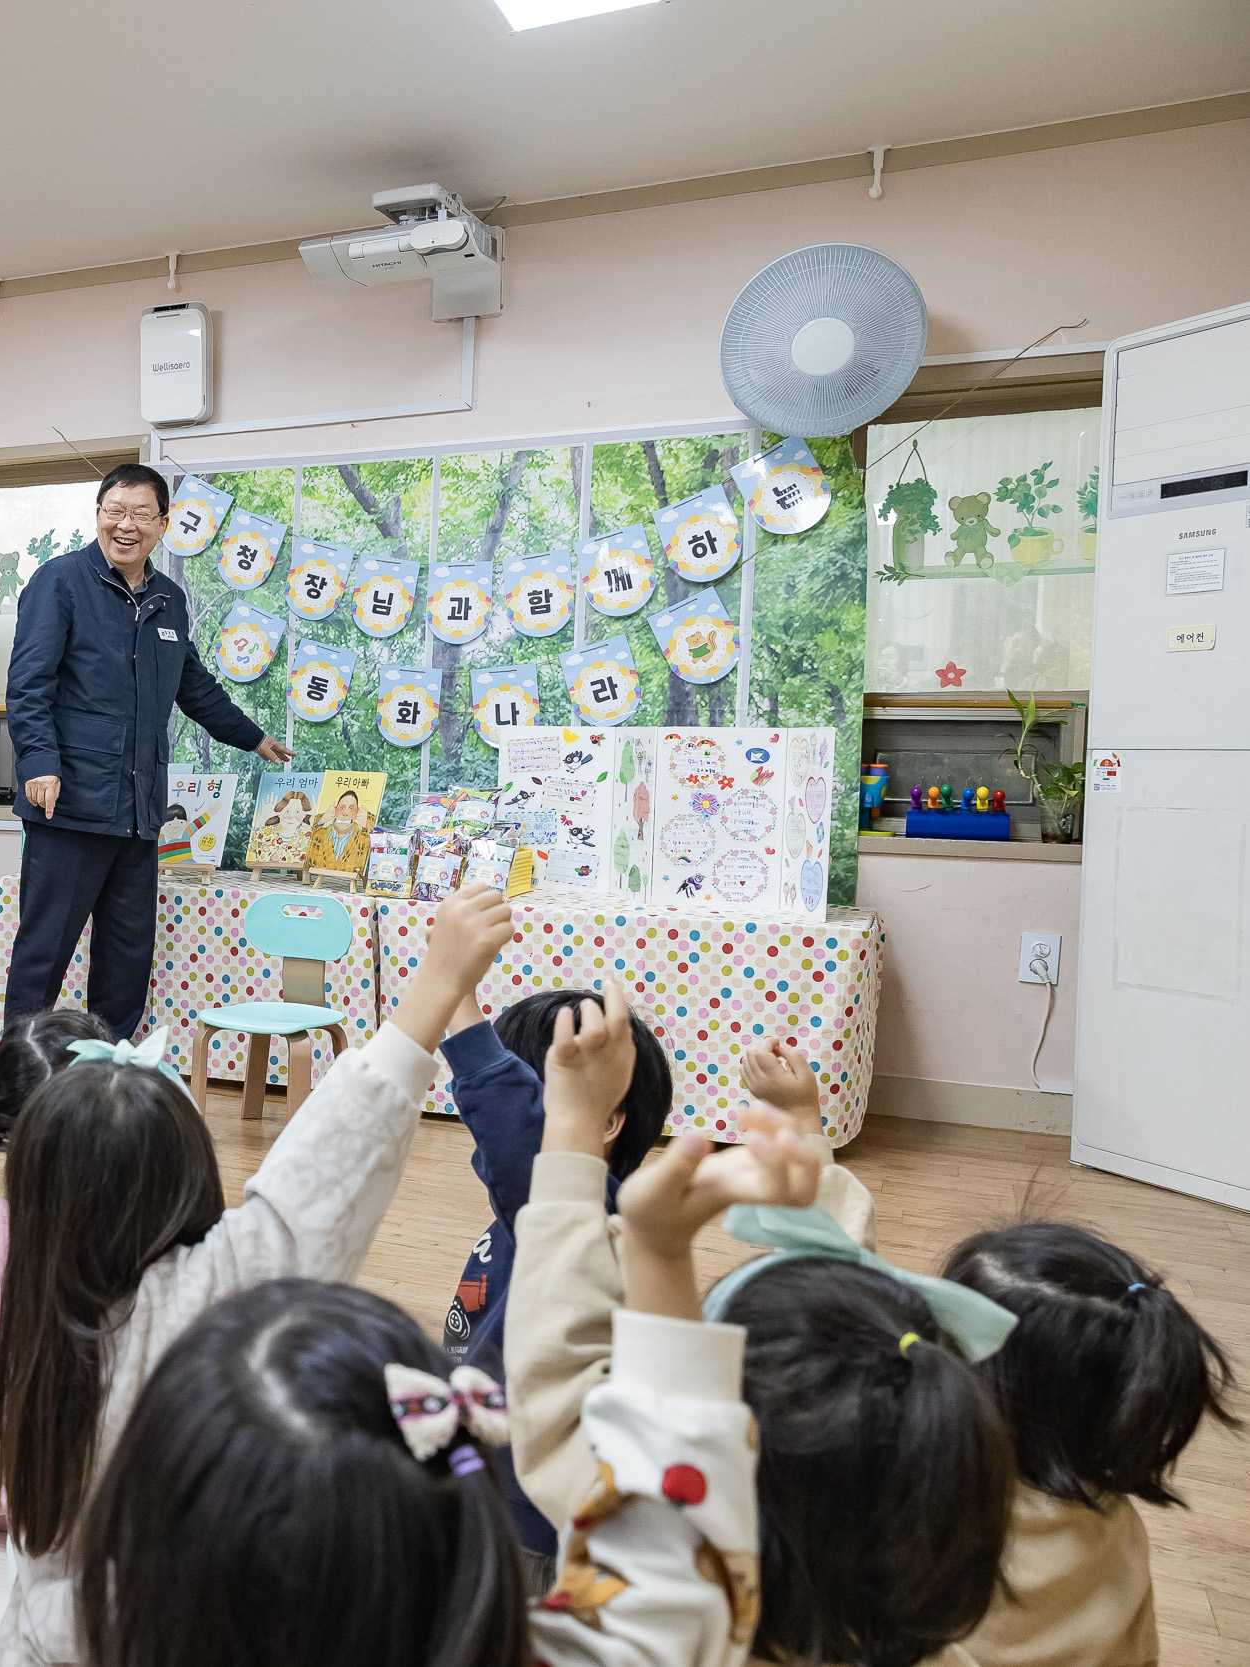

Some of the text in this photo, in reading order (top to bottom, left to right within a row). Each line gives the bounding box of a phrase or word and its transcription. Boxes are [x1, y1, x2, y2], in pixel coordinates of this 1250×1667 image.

[372, 260, 403, 269] HITACHI
[1178, 528, 1217, 540] SAMSUNG
[1176, 632, 1204, 644] 에어컨
[172, 779, 223, 798] 우리 형
[275, 777, 318, 788] 우리 엄마
[336, 776, 370, 789] 우리 아빠
